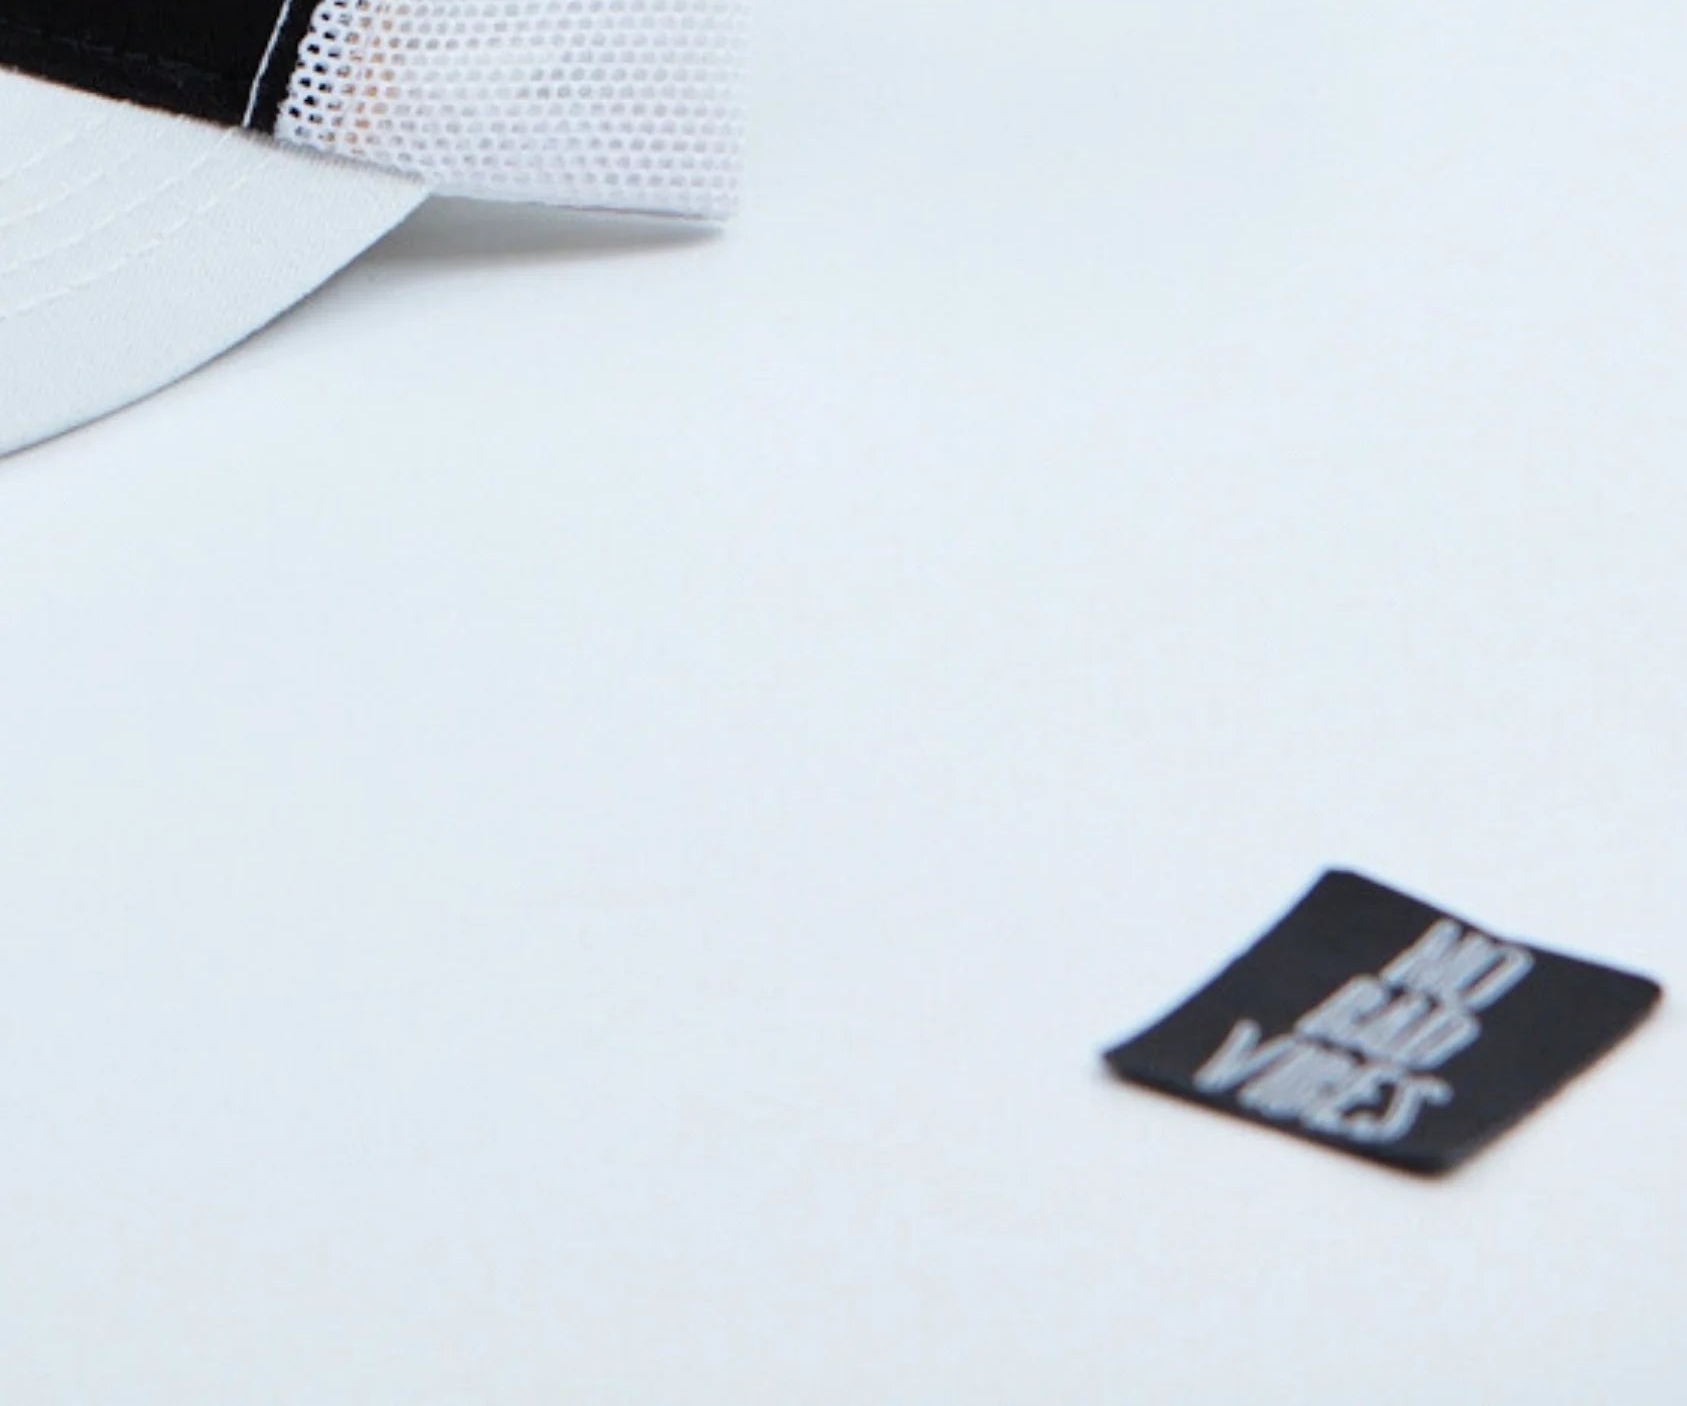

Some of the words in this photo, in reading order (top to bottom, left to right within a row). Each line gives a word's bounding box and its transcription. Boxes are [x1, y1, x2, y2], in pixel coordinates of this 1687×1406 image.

[1378, 917, 1535, 1013] NO
[1294, 973, 1482, 1073] BAD
[1192, 1019, 1454, 1143] VIBES
